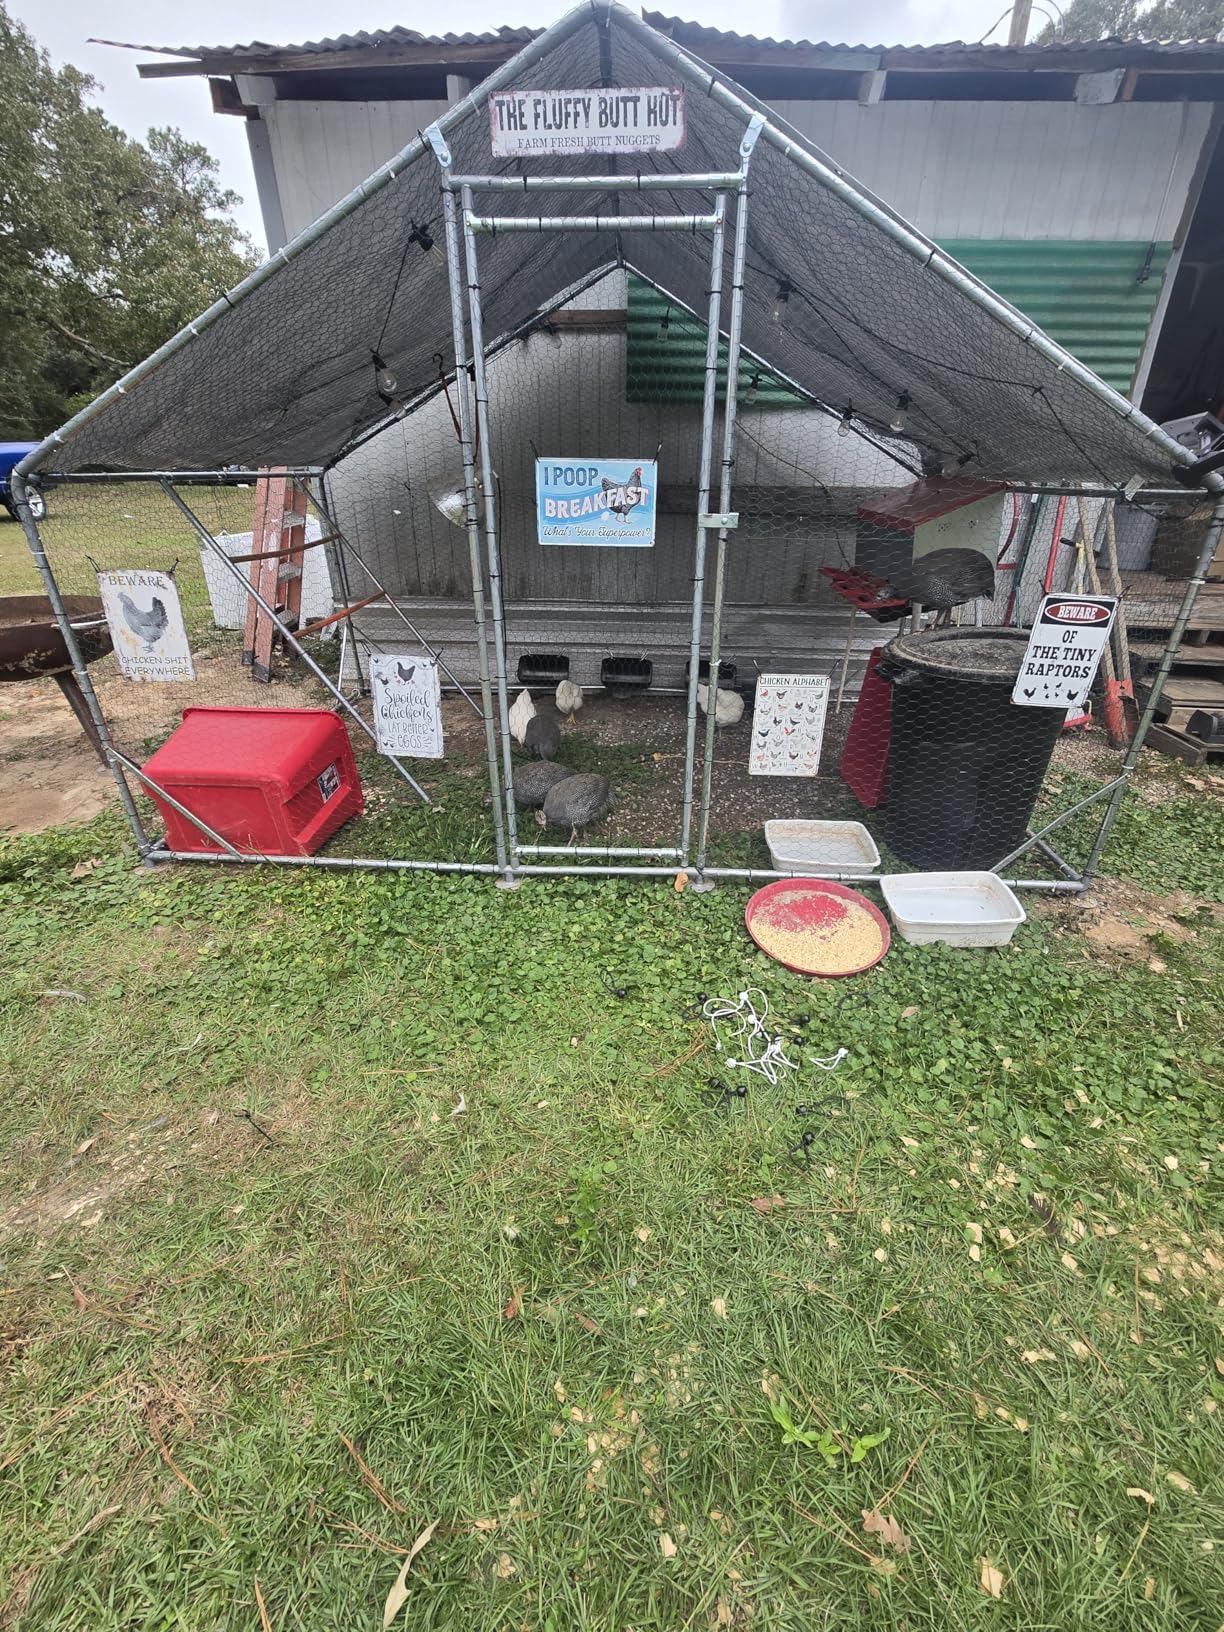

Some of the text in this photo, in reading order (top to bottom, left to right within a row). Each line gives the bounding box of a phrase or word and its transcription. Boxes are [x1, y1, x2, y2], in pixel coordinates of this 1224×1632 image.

[495, 93, 681, 131] THE FLUFFY BUTT HUT
[517, 134, 661, 149] FARM FRESH BUTT NUGGETS
[544, 467, 598, 486] I POOP
[545, 486, 648, 518] BREAKFAST
[109, 575, 165, 587] BEWARE
[1058, 606, 1098, 619] BEWARE
[1062, 630, 1078, 643] OF
[122, 656, 188, 664] CHICKEN SHIT
[1033, 646, 1097, 661] THE TINY
[125, 666, 190, 675] EVERYWHERE
[1025, 663, 1091, 678] RAPTORS
[760, 677, 827, 686] CHICKEN ALPHABET
[384, 688, 430, 707] Spoiled
[381, 703, 432, 723] Chickens
